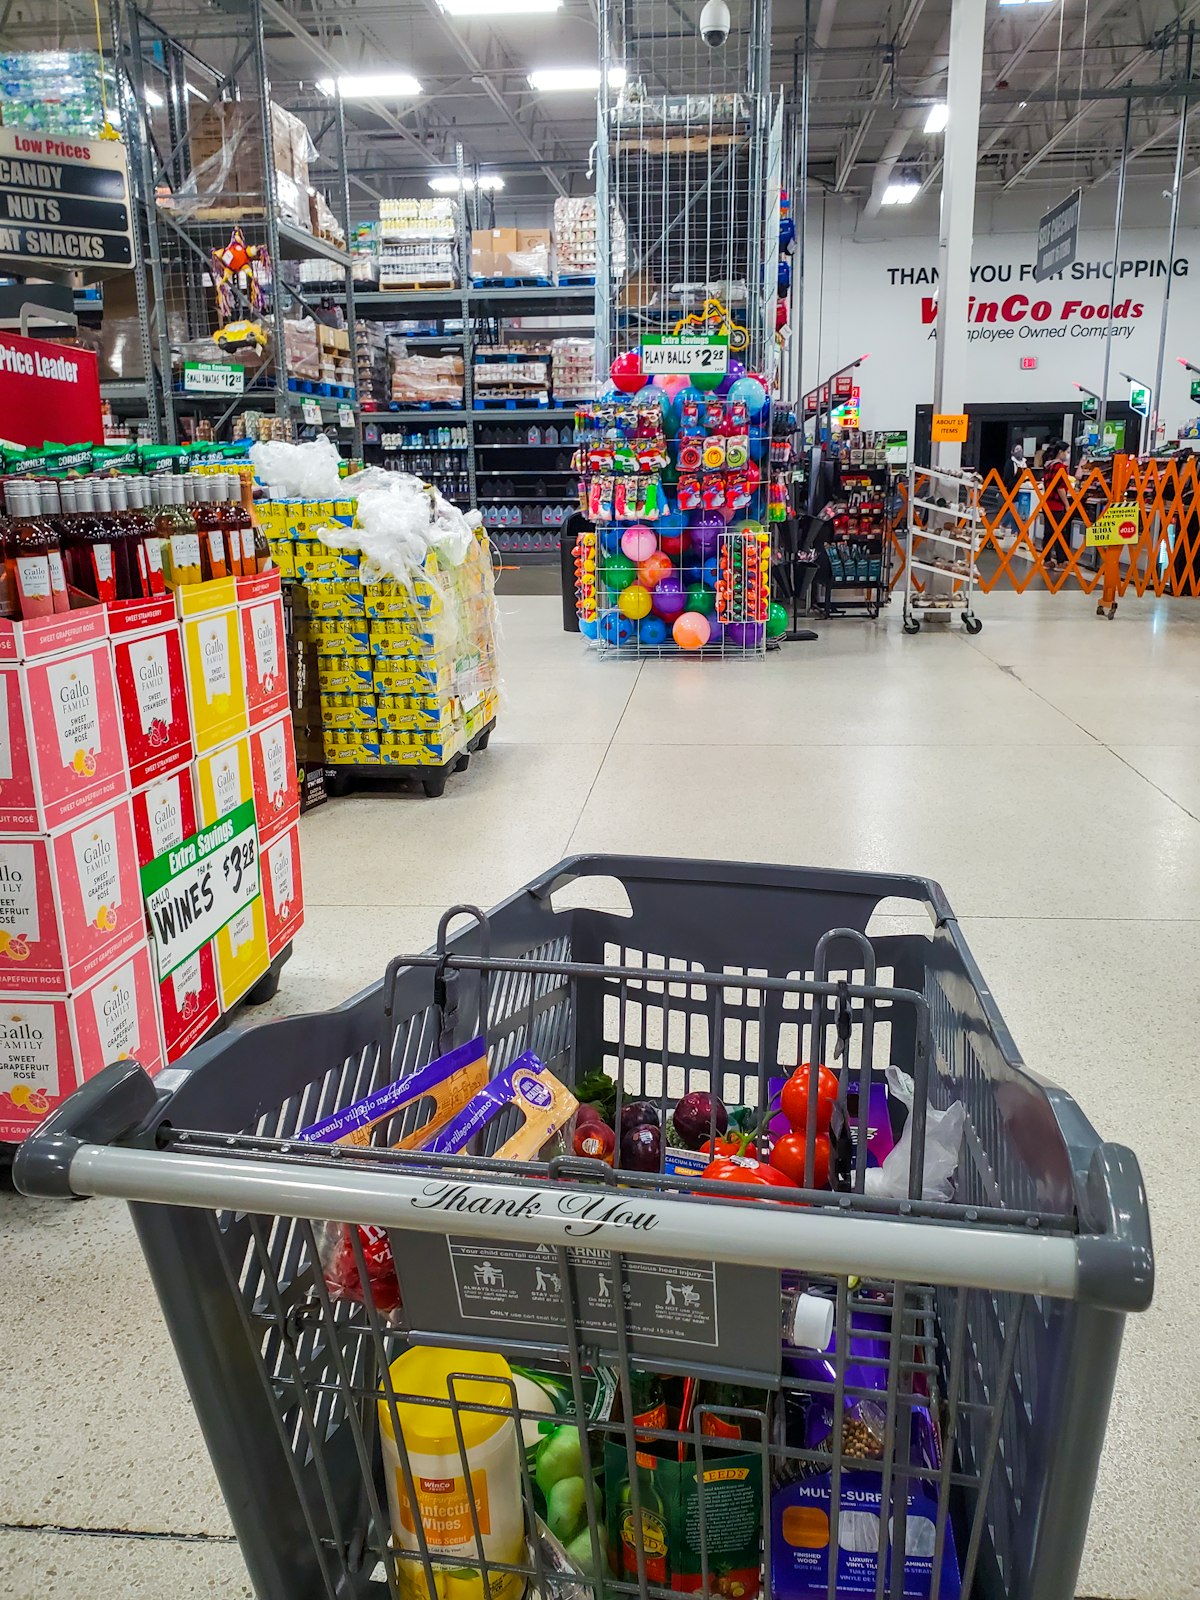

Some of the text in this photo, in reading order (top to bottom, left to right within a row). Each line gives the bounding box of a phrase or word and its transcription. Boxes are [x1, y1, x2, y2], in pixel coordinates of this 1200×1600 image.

[15, 136, 91, 160] Low Prices
[0, 160, 62, 189] CANDY
[6, 194, 60, 222] NUTS
[25, 230, 104, 259] SNACKS
[970, 264, 1012, 282] YOU
[1072, 258, 1189, 280] SHOPPING
[1060, 299, 1145, 320] Foods
[661, 336, 710, 345] Extra Savings
[1018, 325, 1066, 338] Owned
[1070, 324, 1135, 339] Company
[0, 344, 78, 383] Price Leader
[645, 350, 665, 364] PLAY
[668, 350, 692, 364] BALLS
[24, 567, 45, 576] Gallo
[257, 624, 273, 640] Gallo
[204, 639, 224, 656] Gallo
[140, 662, 163, 681] Gallo
[60, 680, 89, 702] Gallo
[142, 677, 163, 691] FAMILY
[62, 696, 90, 714] FAMILY
[143, 698, 168, 713] STRAWBERRY
[148, 692, 161, 702] SWEET
[64, 720, 95, 738] GRAPEFRUIT
[70, 714, 87, 726] SWEET
[74, 732, 88, 744] ROSÉ
[268, 743, 282, 760] Gallo
[217, 769, 235, 788] Gallo
[13, 814, 34, 823] ROSÉ
[154, 804, 176, 825] Gallo
[156, 818, 176, 834] FAMILY
[162, 833, 174, 844] SWEET
[169, 819, 234, 876] Extra Savings
[84, 840, 110, 864] Gallo
[86, 854, 111, 875] FAMILY
[274, 856, 289, 875] Gallo
[88, 876, 116, 897] GRAPEFRUIT
[94, 871, 108, 885] SWEET
[97, 888, 109, 900] ROSÉ
[246, 881, 256, 896] EACH
[152, 888, 170, 910] GALLO
[154, 872, 214, 945] WINES
[40, 976, 61, 984] ROSÉ
[104, 990, 130, 1016] Gallo
[106, 1001, 130, 1027] FAMILY
[0, 1024, 43, 1040] Gallo
[107, 1021, 135, 1048] GRAPEFRUIT
[112, 1019, 127, 1035] SWEET
[0, 1063, 49, 1071] GRAPEFRUIT
[303, 1118, 343, 1142] Heavenly
[665, 1156, 688, 1165] CALCIUM
[410, 1182, 659, 1237] Thank You
[444, 1536, 467, 1544] Scent
